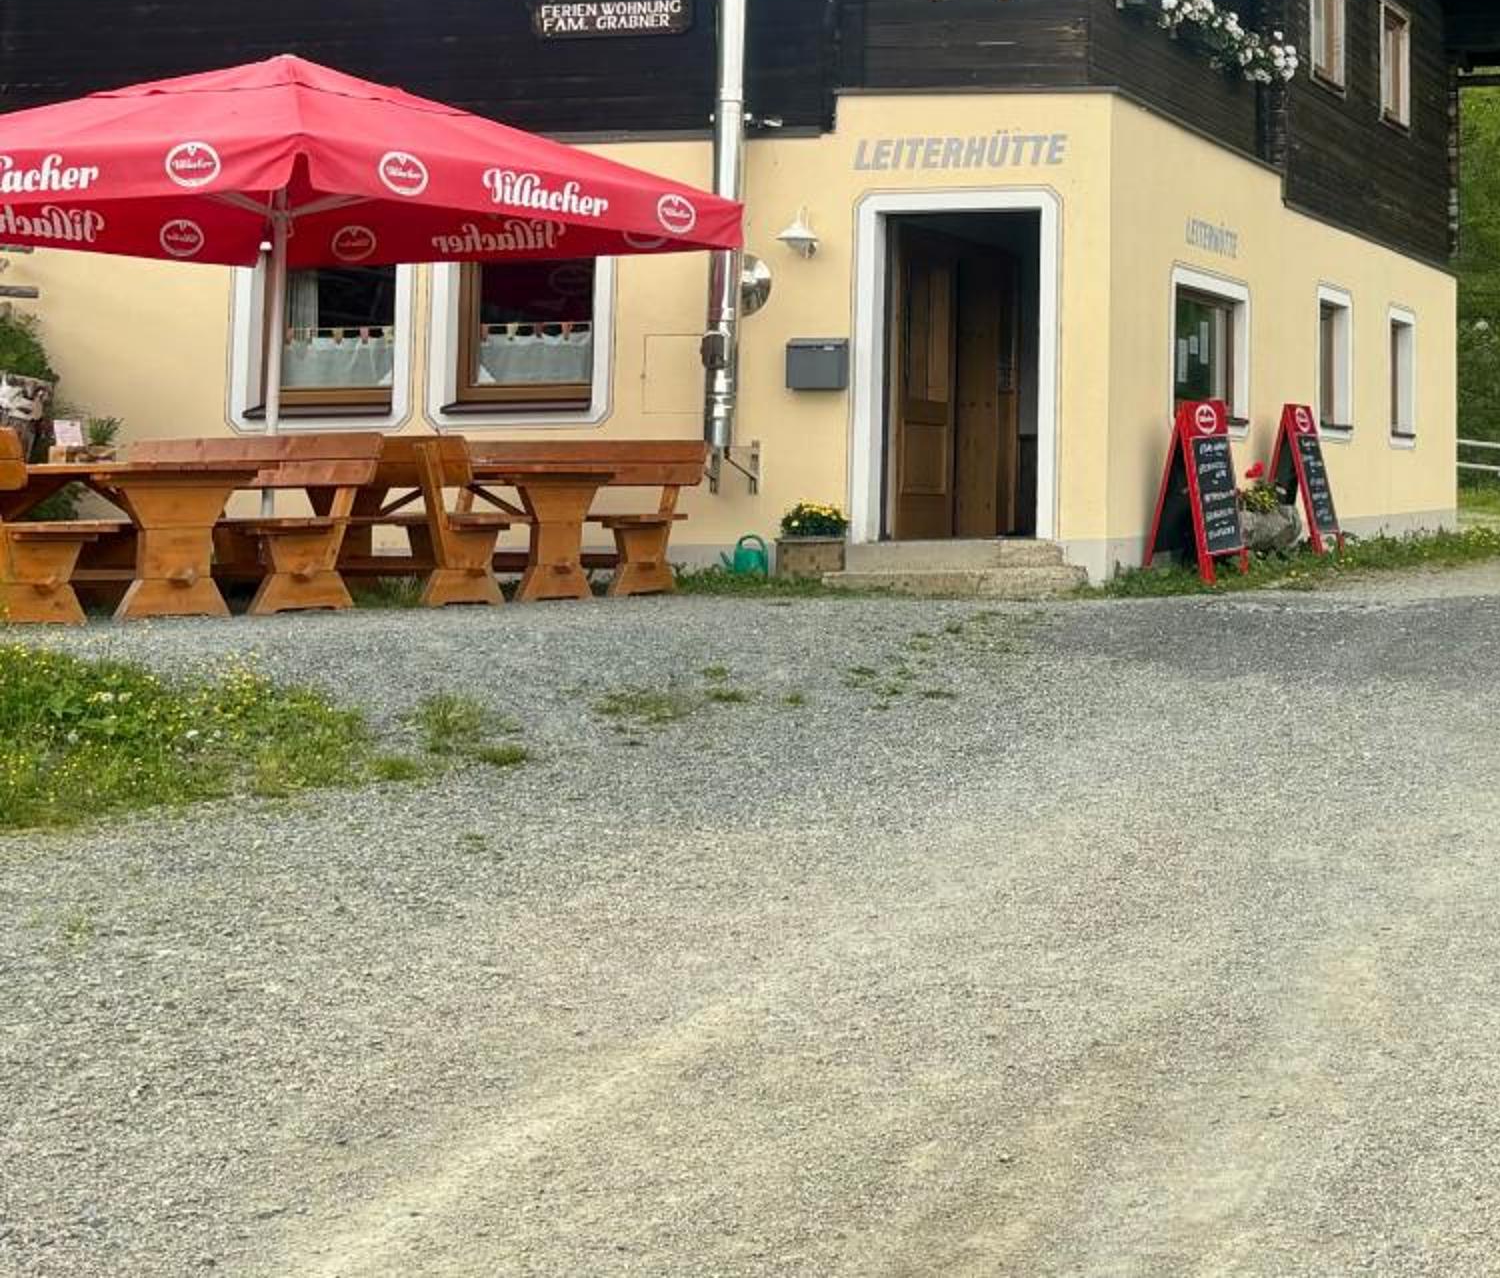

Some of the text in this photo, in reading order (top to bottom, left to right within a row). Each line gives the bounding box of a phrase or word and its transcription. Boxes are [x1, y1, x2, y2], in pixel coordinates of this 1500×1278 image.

[541, 0, 682, 19] FERIEN WOHNUNG
[543, 14, 671, 32] FAM. GRABNER
[853, 129, 1068, 171] LEITERHÜTTE
[482, 168, 609, 217] Villacher
